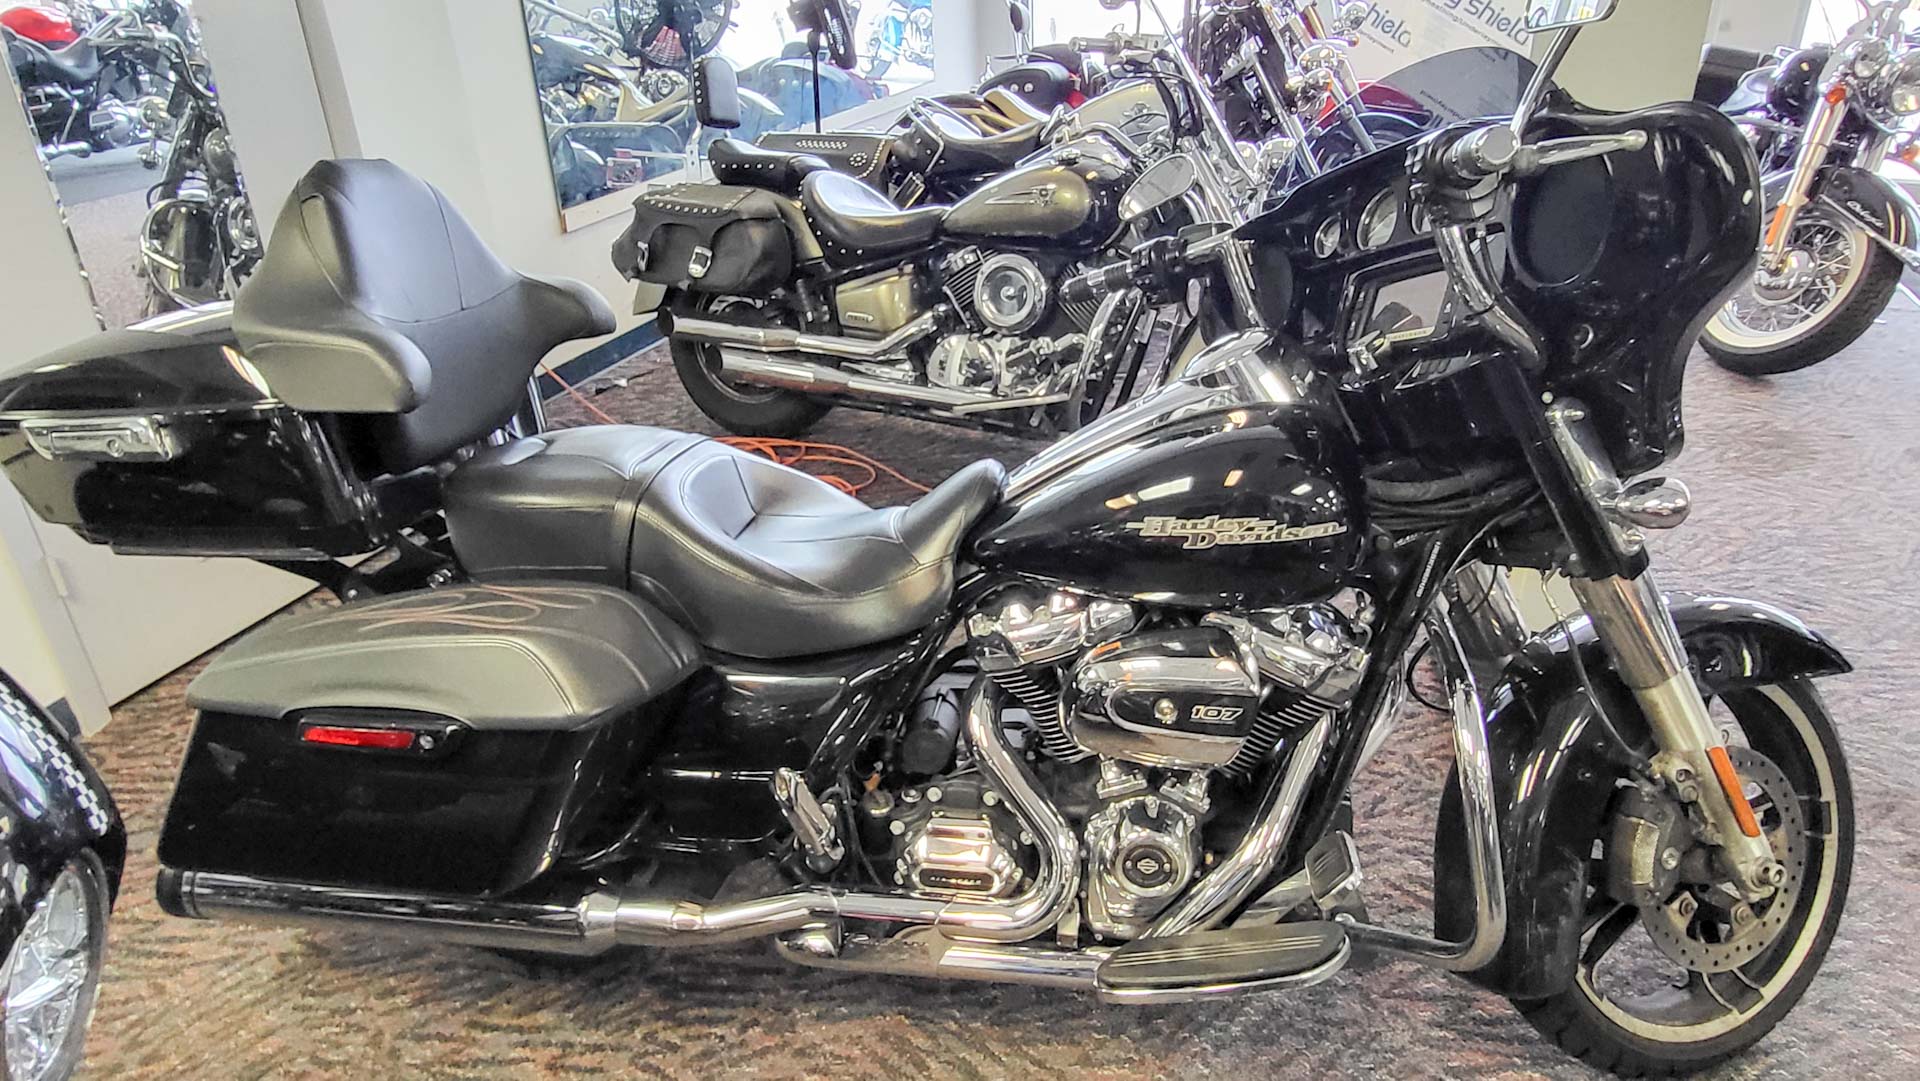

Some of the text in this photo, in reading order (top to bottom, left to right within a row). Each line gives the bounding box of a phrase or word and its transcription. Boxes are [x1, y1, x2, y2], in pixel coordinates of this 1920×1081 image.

[1130, 515, 1274, 537] Harley
[1183, 521, 1347, 549] Davidson
[1190, 705, 1243, 720] 107
